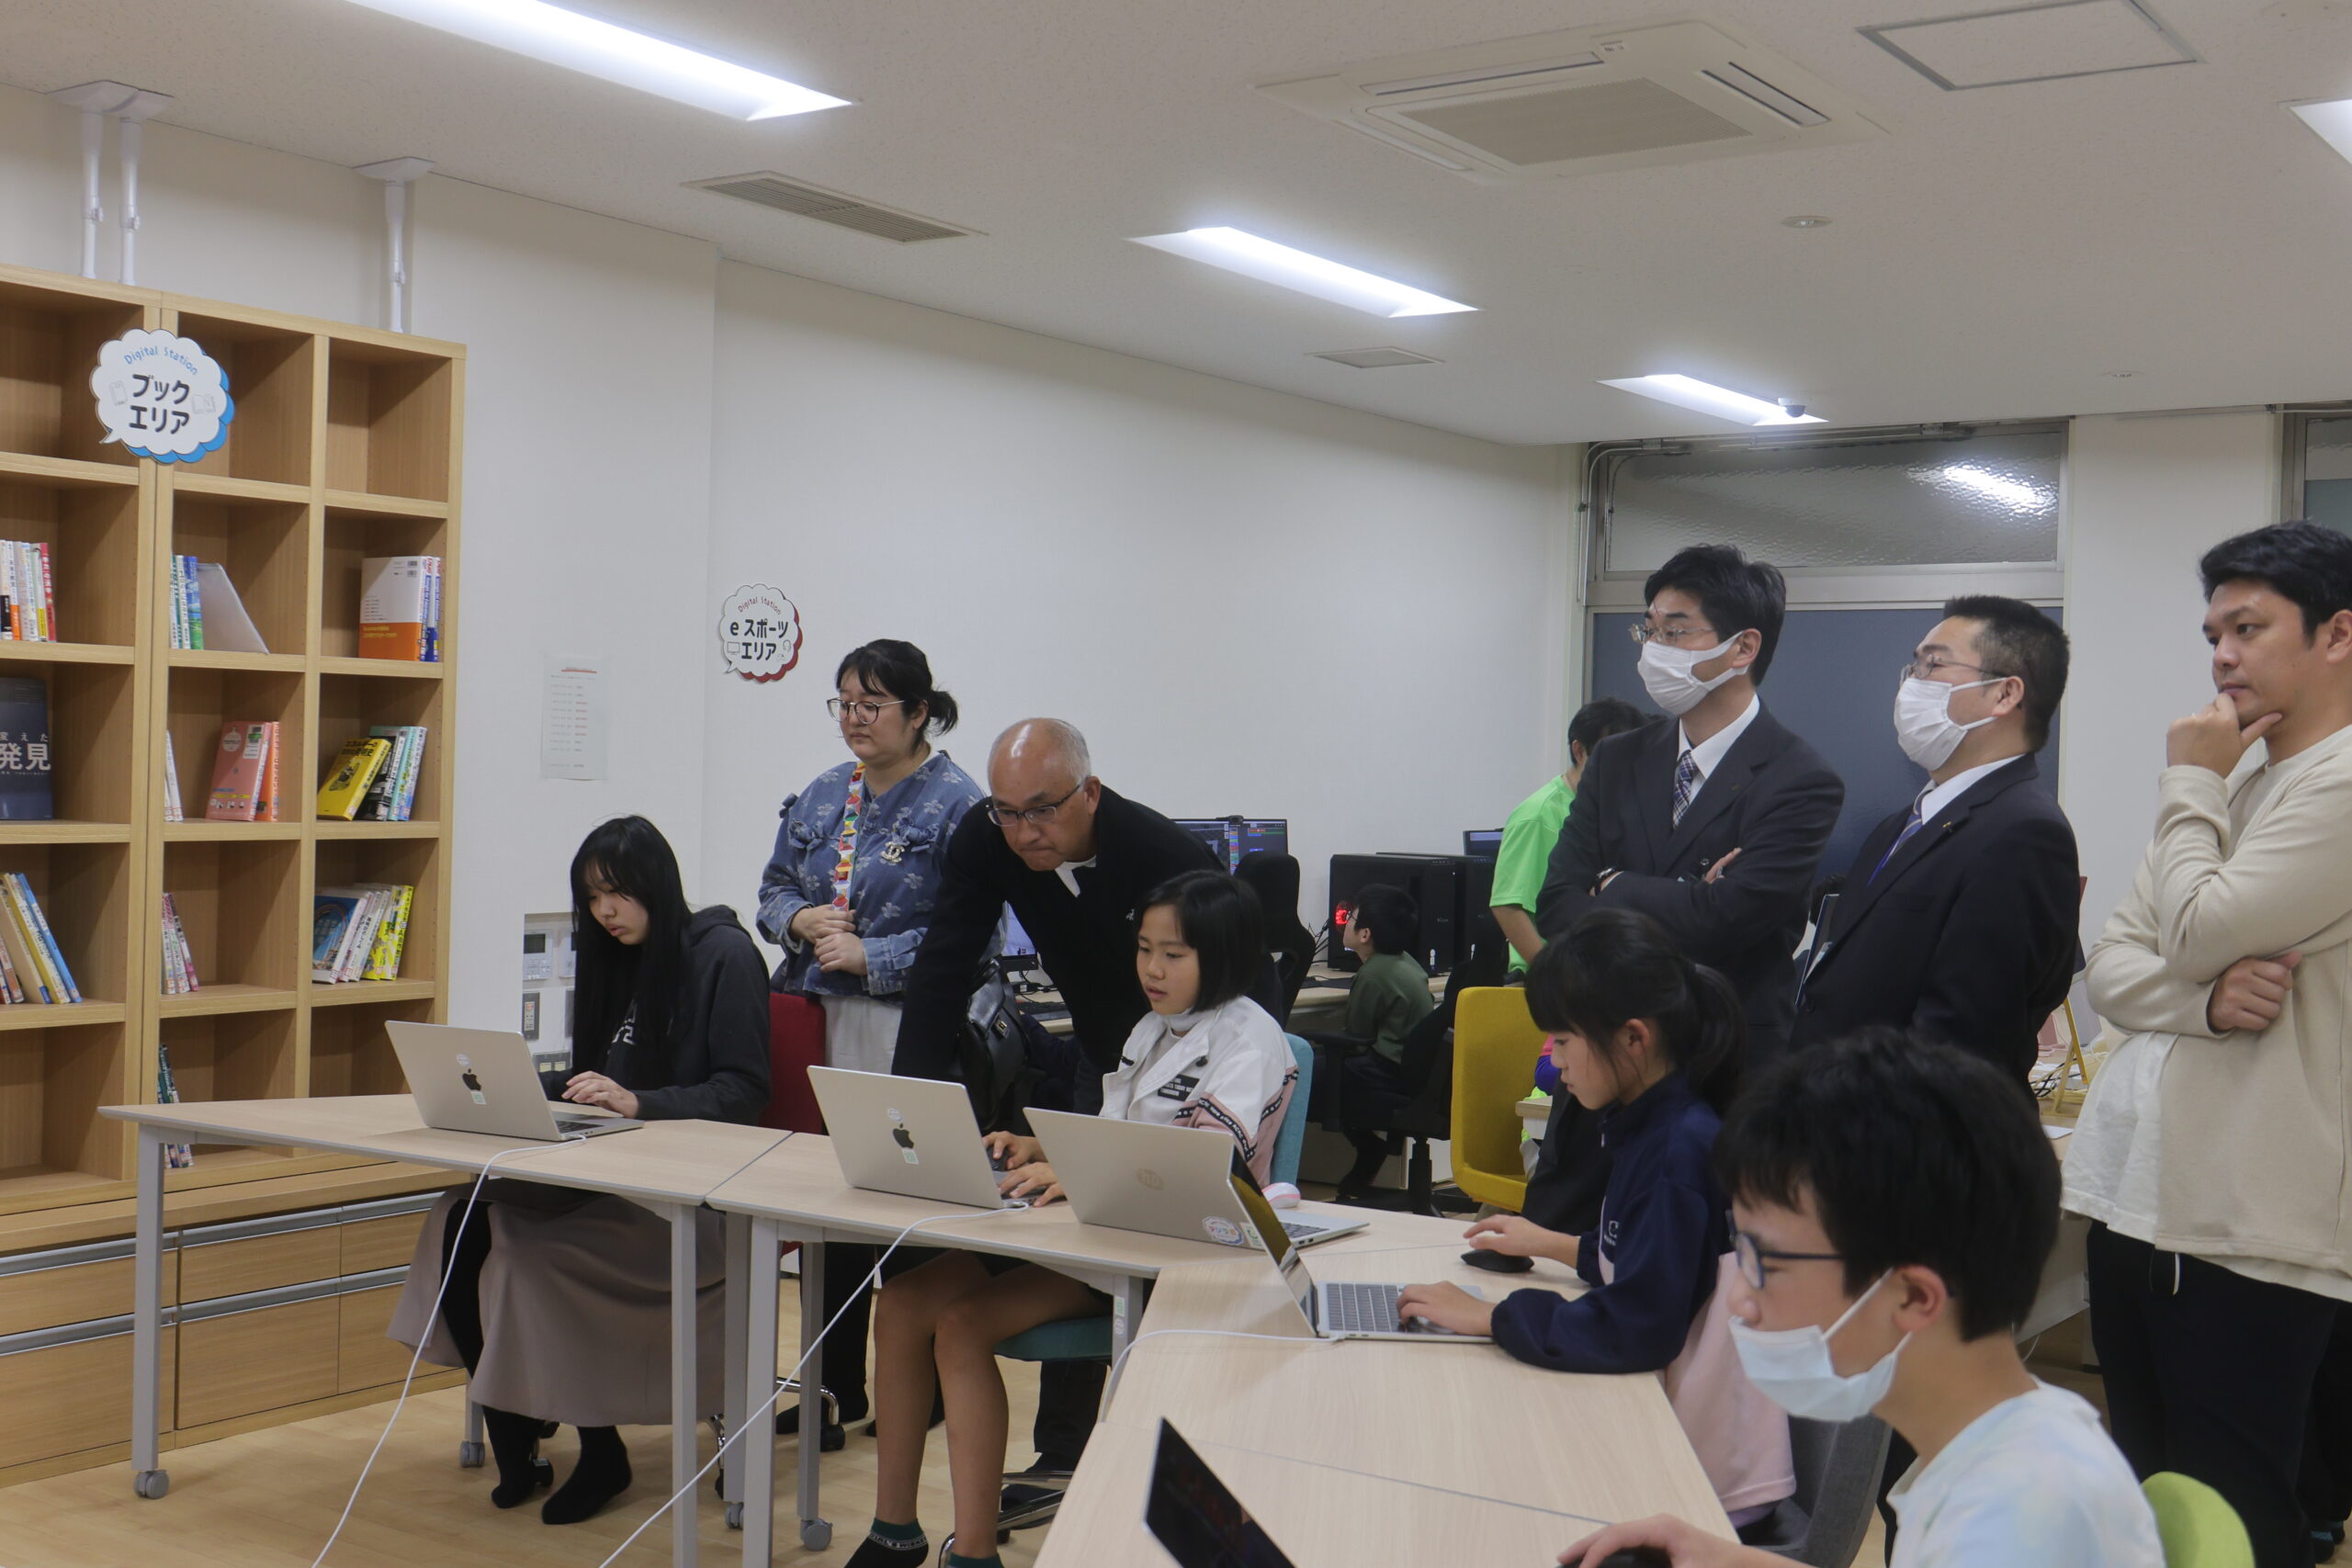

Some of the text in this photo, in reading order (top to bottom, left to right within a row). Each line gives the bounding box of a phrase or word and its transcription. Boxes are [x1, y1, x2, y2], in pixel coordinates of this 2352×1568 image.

[124, 345, 198, 376] Digital Station
[131, 373, 190, 404] ブック
[129, 405, 190, 434] エリア
[738, 596, 781, 615] Digital Station
[729, 618, 788, 638] eスポーツ
[741, 642, 777, 660] エリア
[0, 742, 51, 771] 発見
